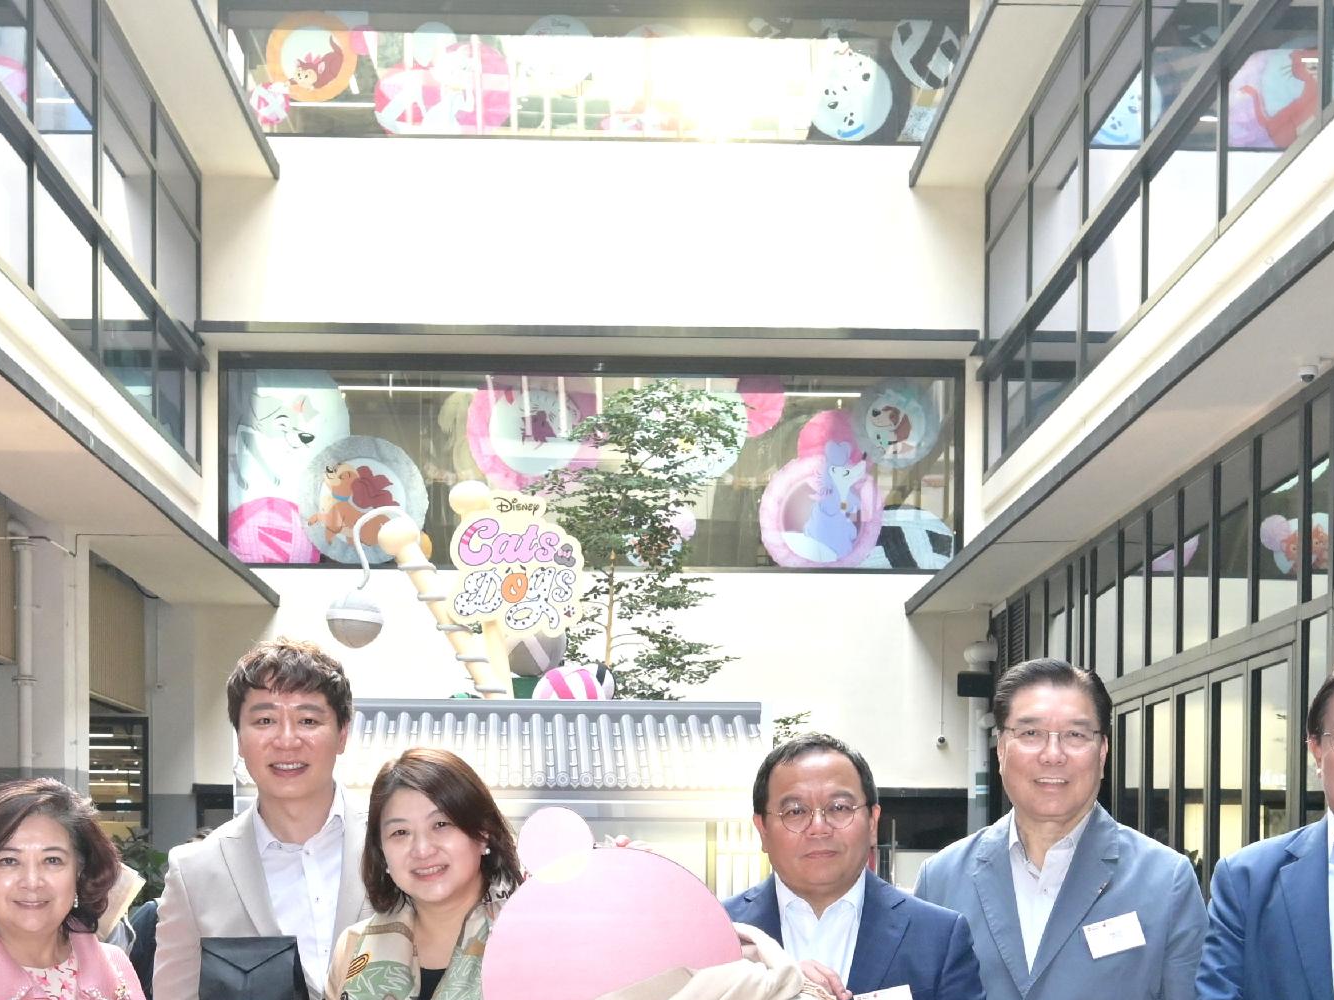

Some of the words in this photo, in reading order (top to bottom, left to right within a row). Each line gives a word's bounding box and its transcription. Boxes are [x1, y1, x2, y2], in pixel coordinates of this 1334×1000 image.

[493, 497, 540, 516] Disney
[458, 518, 560, 567] Cats
[454, 565, 577, 631] Dogs
